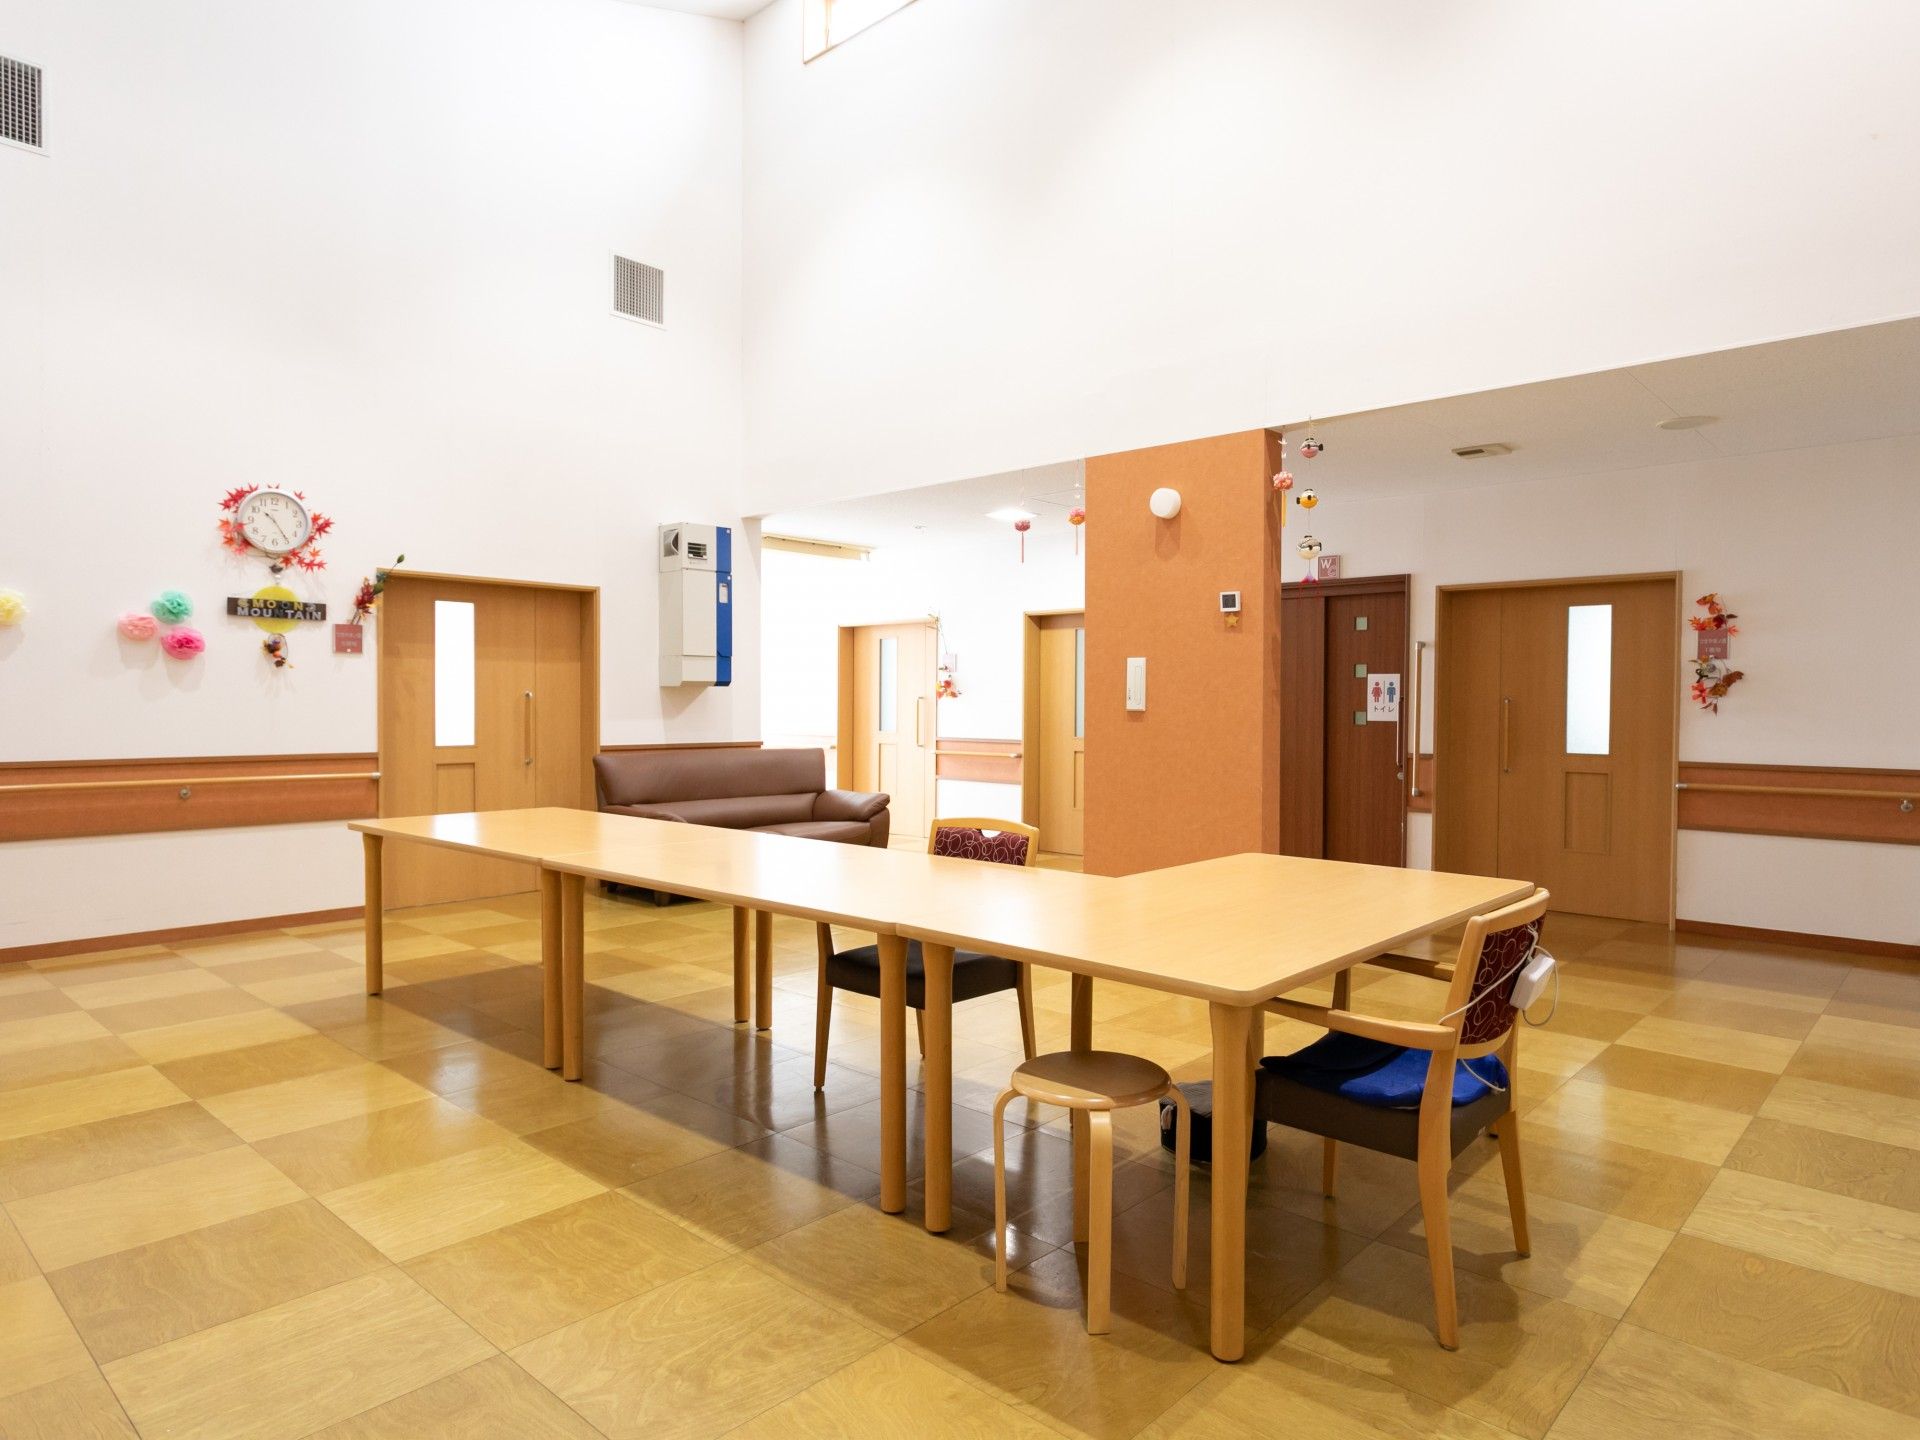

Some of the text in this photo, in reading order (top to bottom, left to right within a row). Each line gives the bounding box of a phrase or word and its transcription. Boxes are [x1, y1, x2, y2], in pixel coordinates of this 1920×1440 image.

[260, 499, 267, 507] 11
[271, 497, 279, 506] 12
[292, 510, 298, 518] 2
[248, 516, 255, 524] 9
[252, 527, 259, 535] 8
[271, 538, 279, 546] 6
[237, 607, 322, 620] MOUNTAIN
[1374, 705, 1396, 713] トイレ
